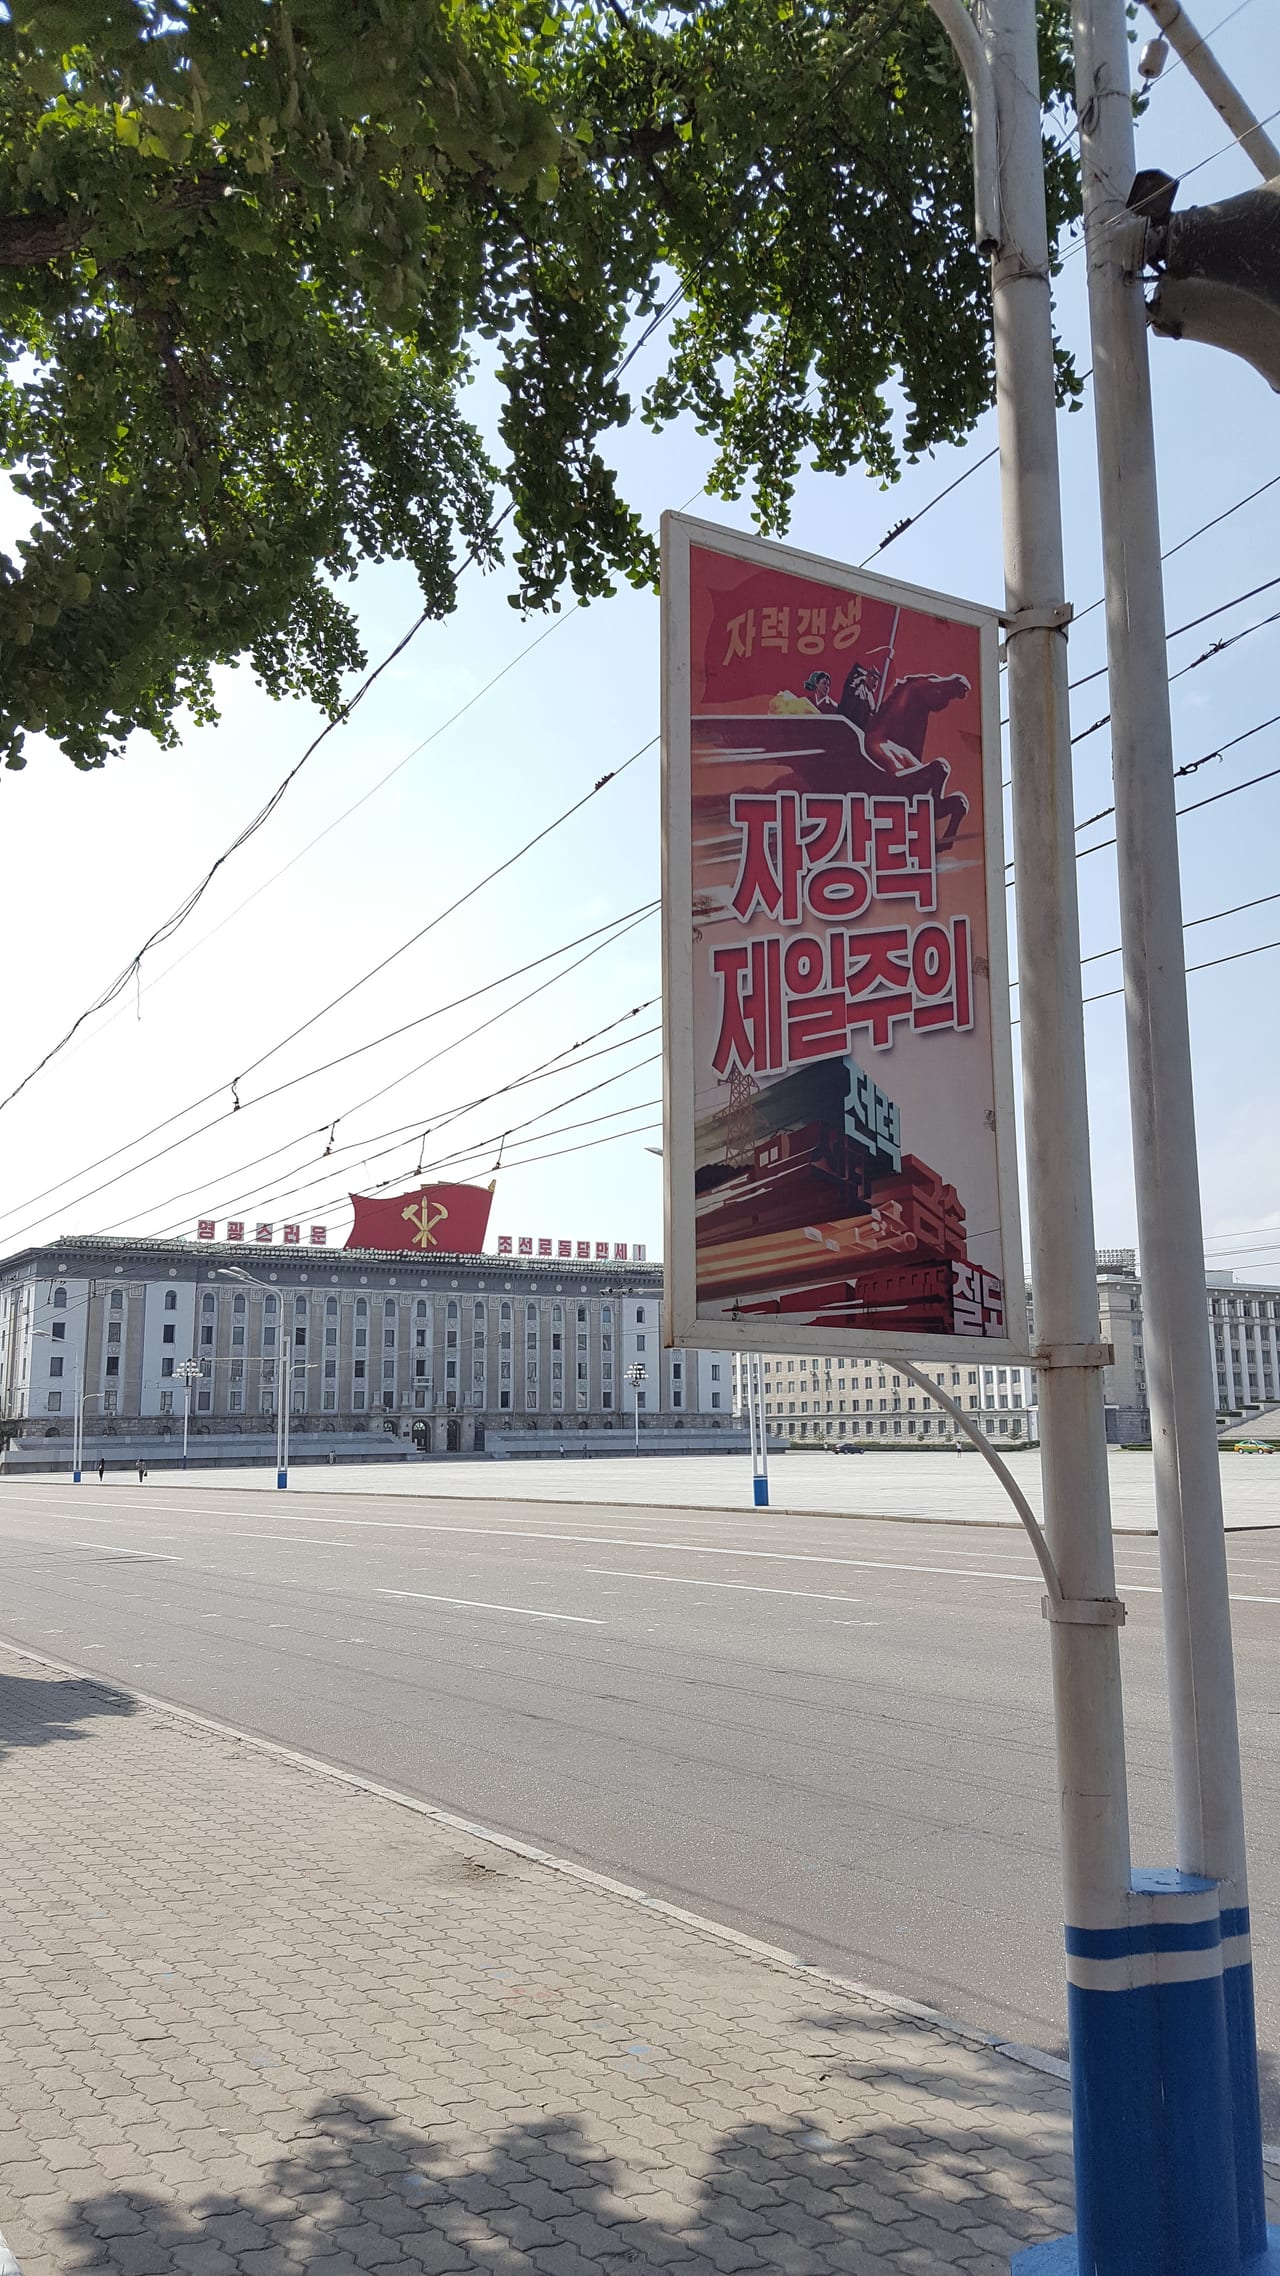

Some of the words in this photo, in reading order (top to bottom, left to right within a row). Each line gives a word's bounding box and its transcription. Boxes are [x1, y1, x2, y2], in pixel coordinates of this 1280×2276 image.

[722, 594, 862, 666] 자력갱생
[729, 790, 938, 924] 자강력
[710, 915, 974, 1080] 제일주의
[843, 1056, 902, 1174] 전력
[198, 1220, 327, 1245] 영광스러운
[952, 1261, 1004, 1338] 철도
